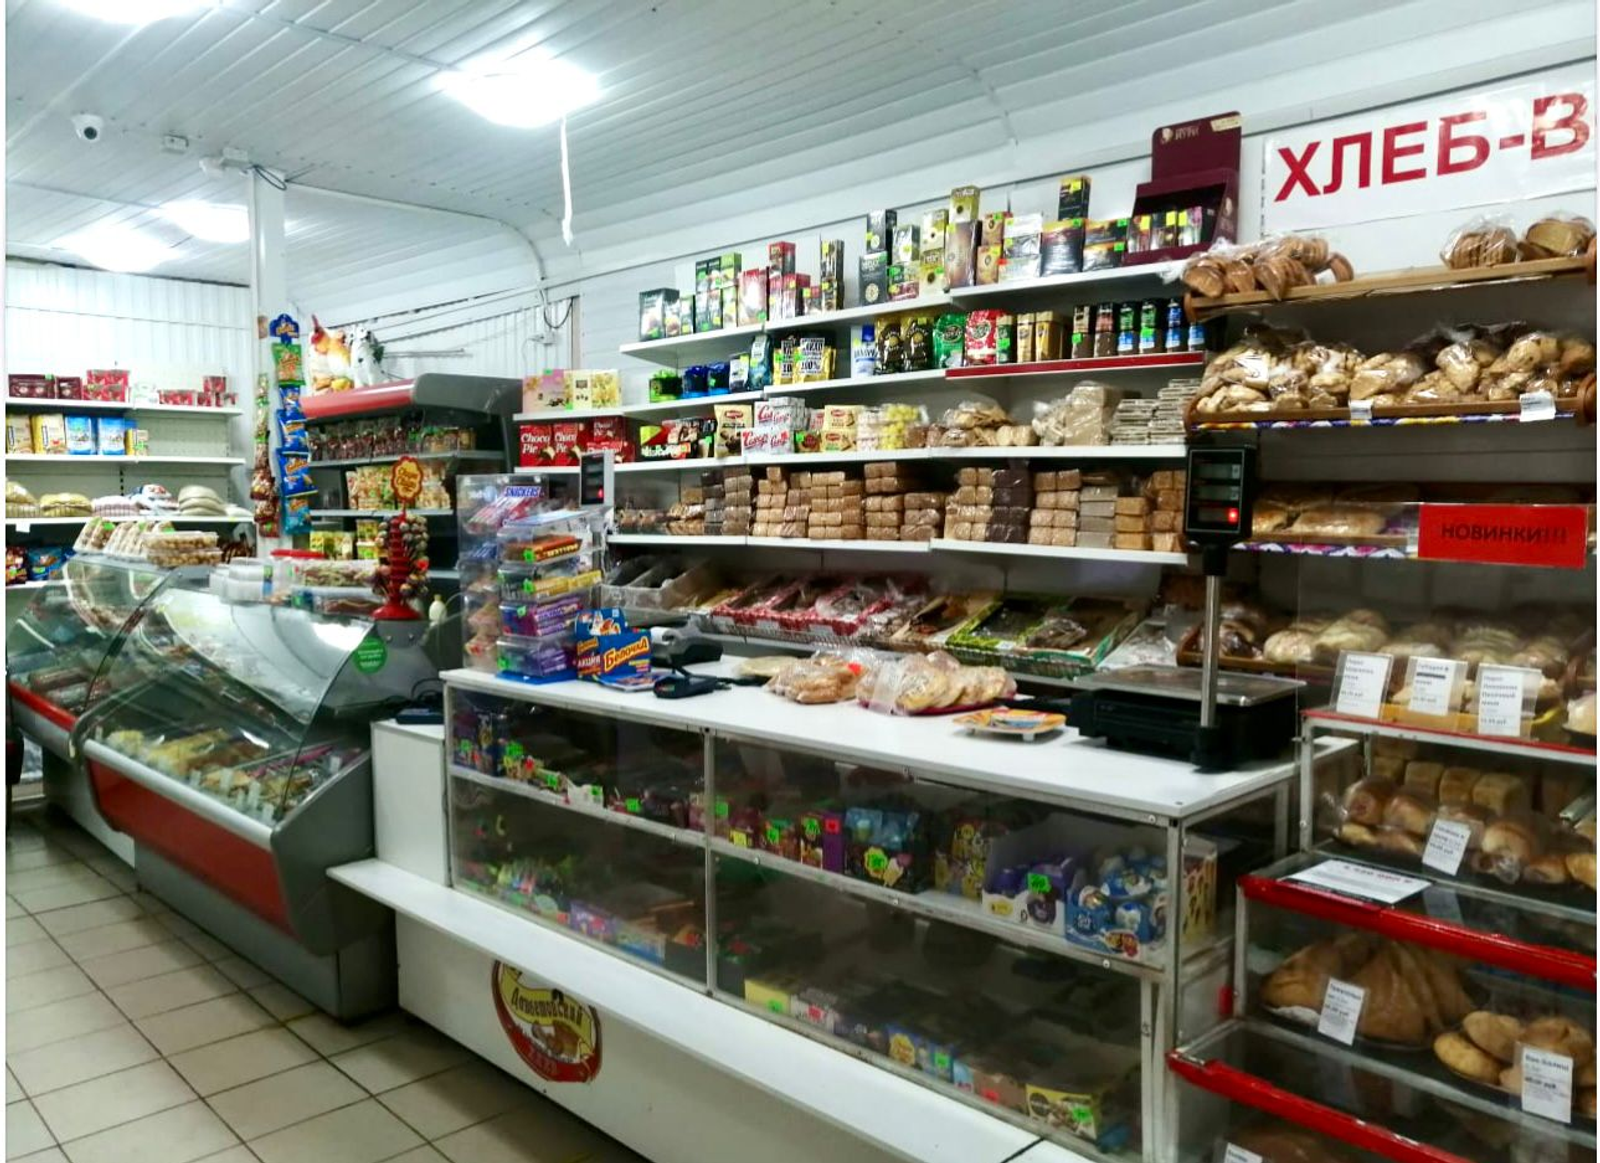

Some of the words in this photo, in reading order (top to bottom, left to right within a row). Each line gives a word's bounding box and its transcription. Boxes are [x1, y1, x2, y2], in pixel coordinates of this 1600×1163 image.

[520, 433, 550, 443] Choco
[522, 443, 539, 454] Pie
[505, 486, 540, 497] SNICKERS
